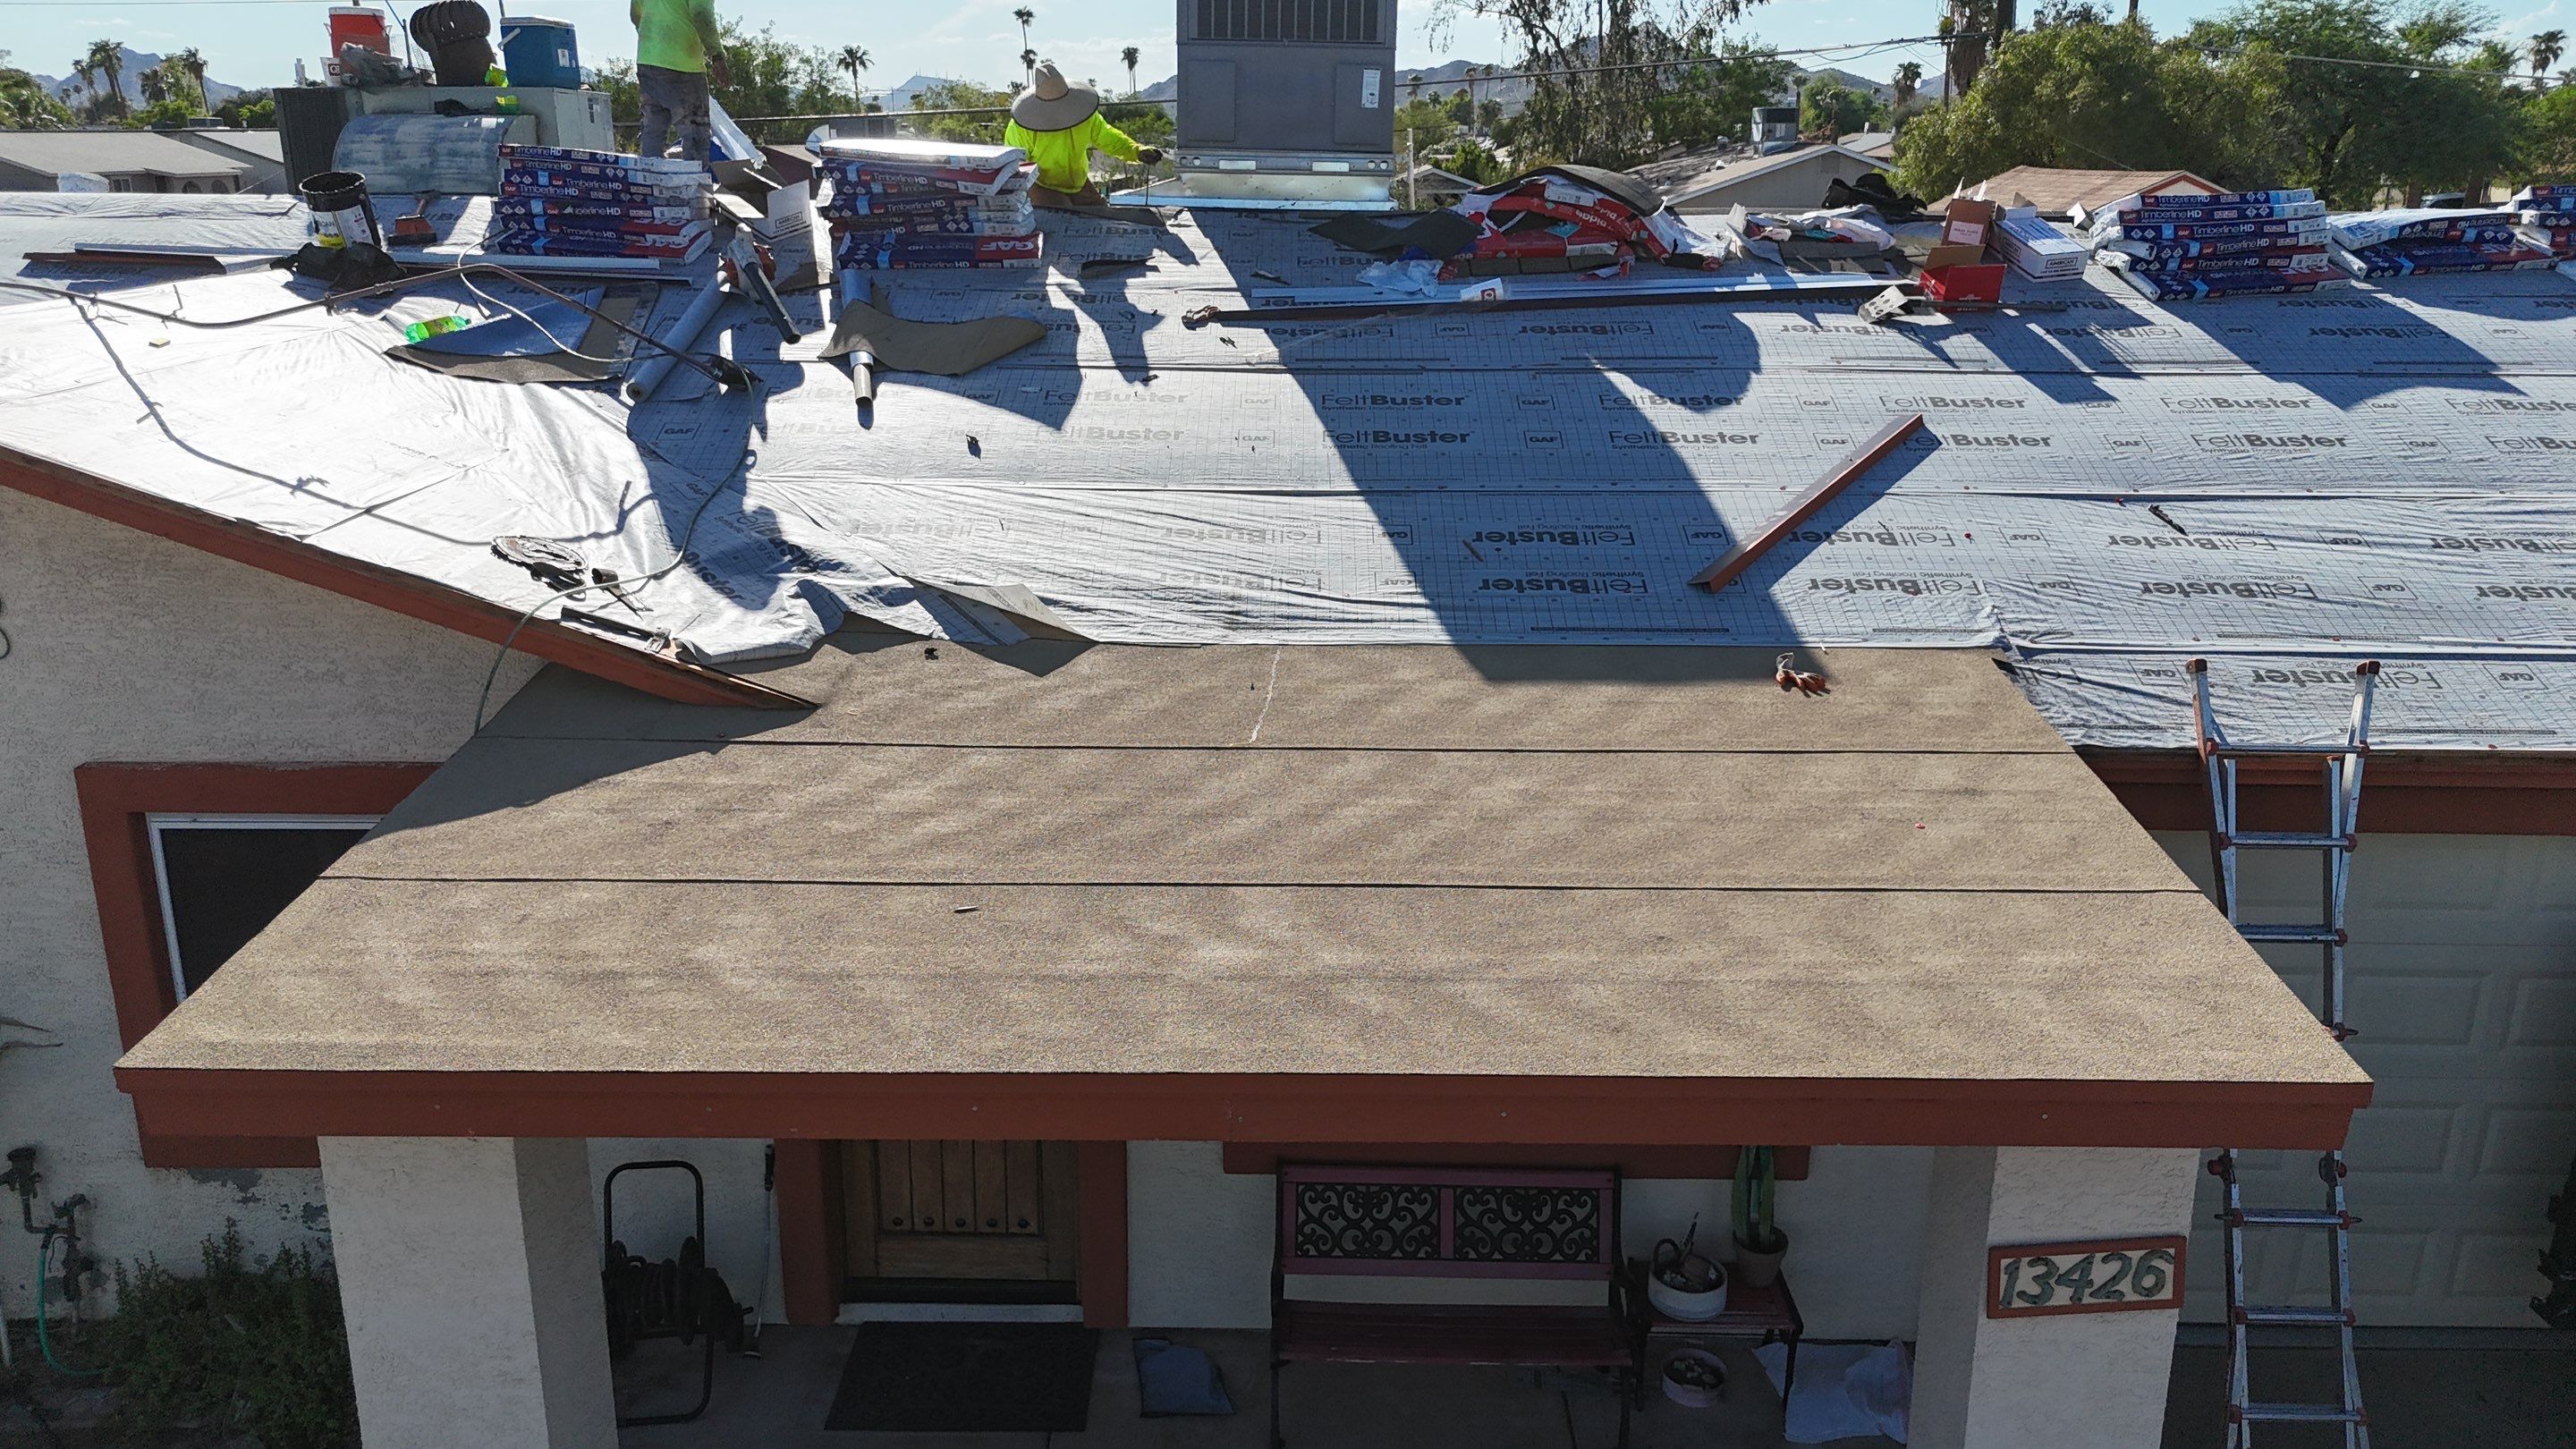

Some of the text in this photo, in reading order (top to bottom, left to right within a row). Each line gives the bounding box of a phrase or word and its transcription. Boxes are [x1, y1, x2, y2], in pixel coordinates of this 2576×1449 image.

[980, 241, 1035, 250] GAF
[2048, 258, 2075, 267] AMERICAN
[1519, 324, 1654, 335] FeltBuster
[2309, 326, 2450, 339] FeltBuster
[1045, 389, 1188, 403] FeltBuster
[1321, 394, 1466, 407] FeltBuster
[1598, 394, 1744, 406] FeltBuster
[1878, 395, 2027, 409] FeltBuster
[2159, 397, 2310, 410] FeltBuster
[1036, 426, 1185, 441] FeltBuster
[1322, 429, 1471, 444] FeltBuster
[1609, 430, 1759, 445] FeltBuster
[1902, 433, 2053, 447] FeltBuster
[2112, 440, 2143, 448] GAF
[2190, 434, 2347, 448] FeltBuster
[1471, 530, 1636, 547] FeltBuster
[1787, 530, 1956, 547] FeltBuster
[2108, 535, 2278, 551] FeltBuster
[1478, 578, 1649, 595] FeltBuster
[1808, 577, 1981, 596] FeltBuster
[2034, 581, 2071, 589] GAF
[2140, 581, 2318, 599] FeltBuster
[2371, 583, 2406, 592] GAF
[2144, 669, 2176, 677] GAF
[2252, 669, 2443, 689] Feltuster
[2498, 672, 2534, 681] GAF
[2000, 1249, 2175, 1308] 13426
